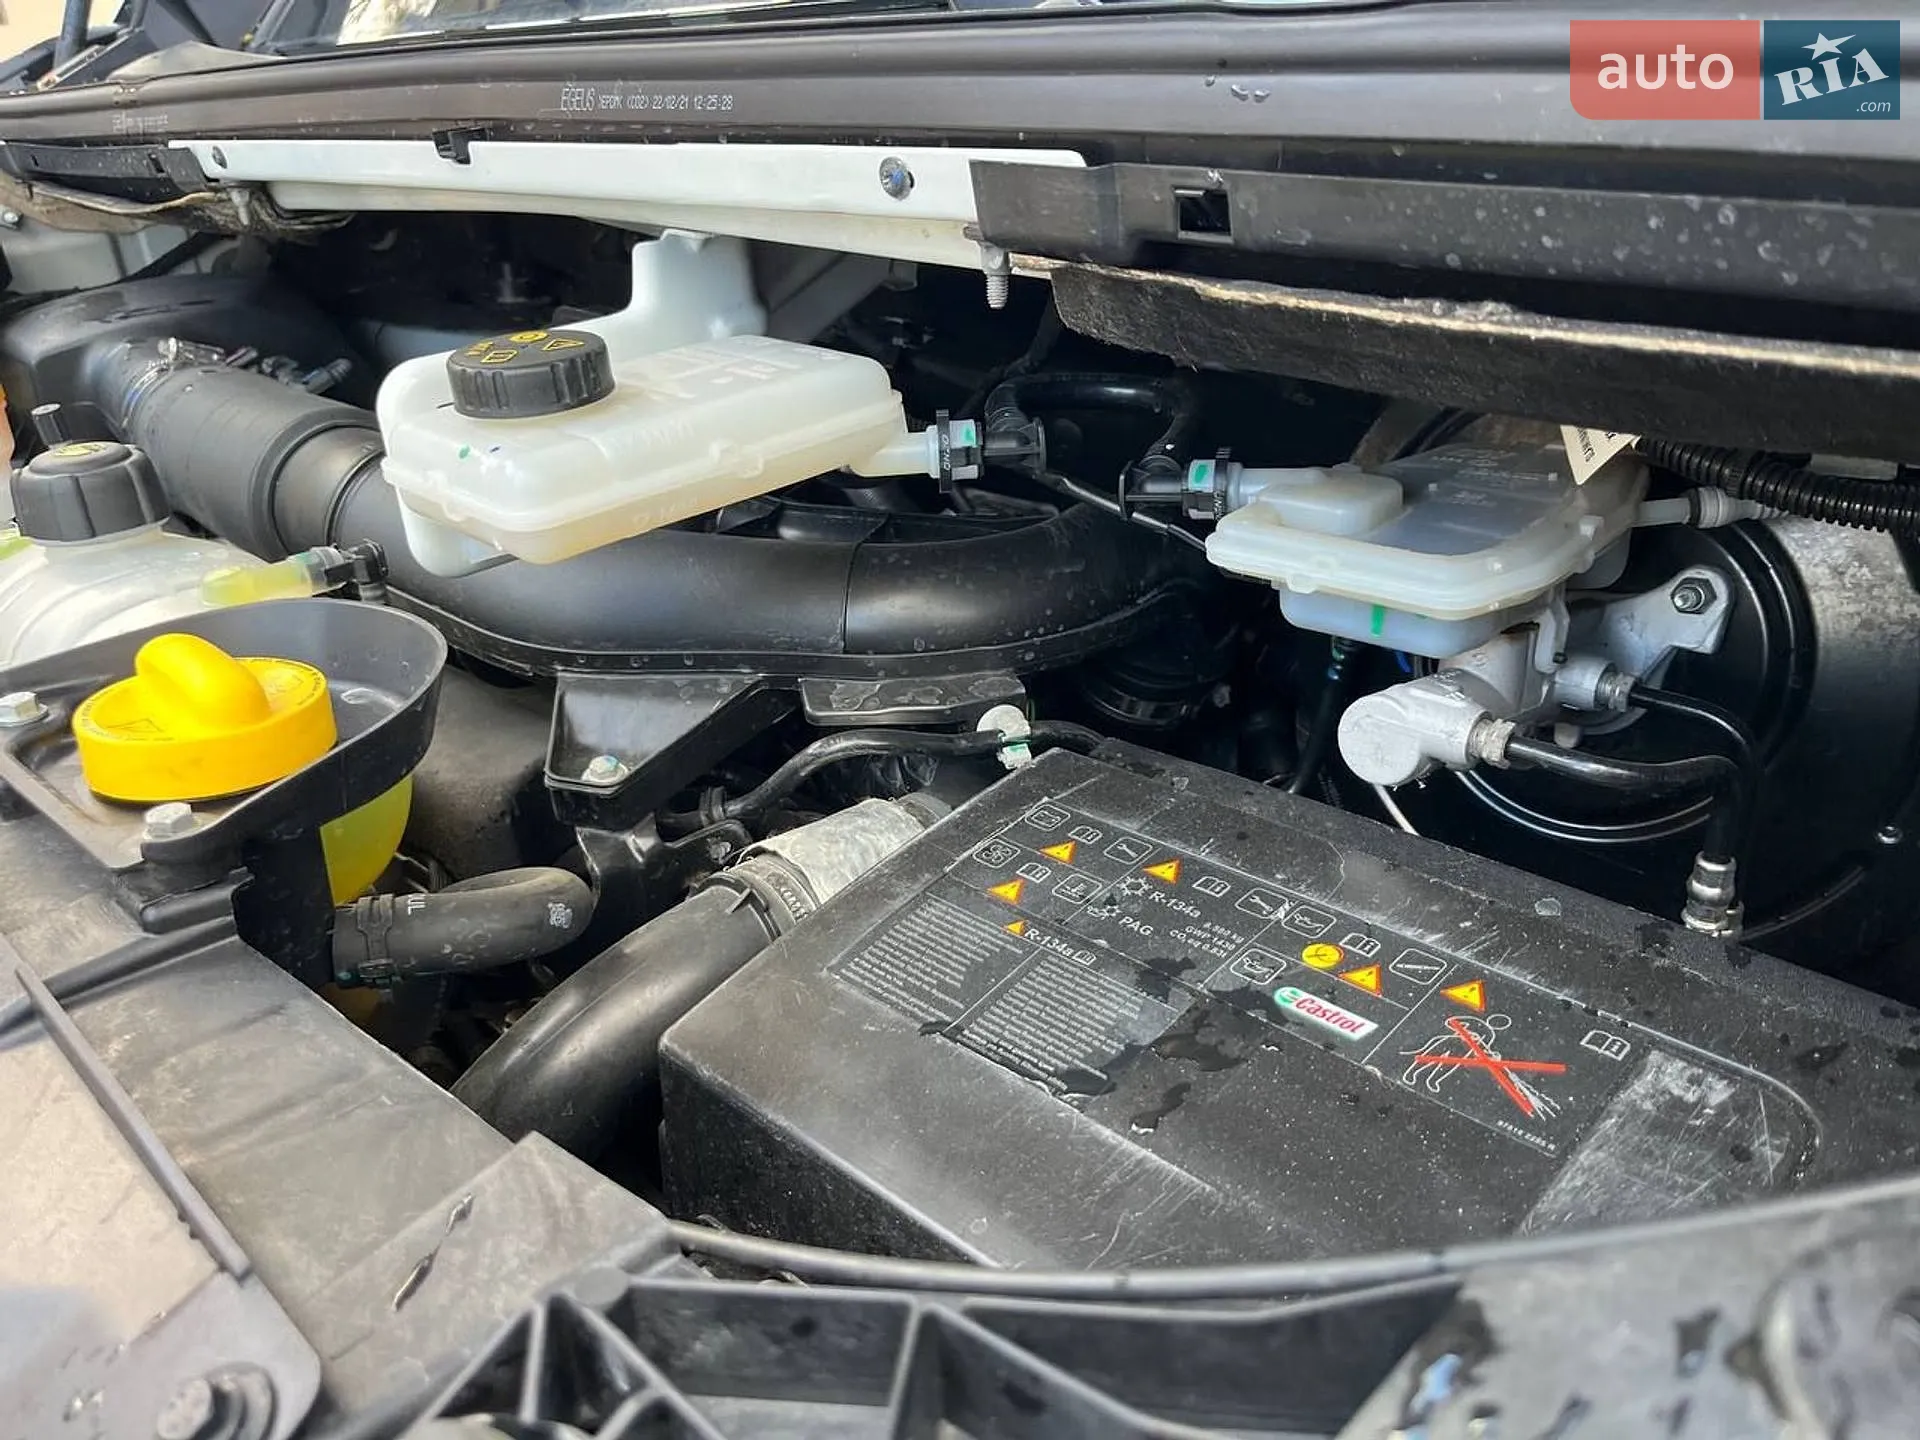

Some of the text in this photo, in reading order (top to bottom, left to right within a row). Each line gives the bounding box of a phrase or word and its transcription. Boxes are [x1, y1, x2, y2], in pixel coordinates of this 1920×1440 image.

[1149, 890, 1202, 918] R-134a
[1118, 916, 1154, 936] PAG
[1024, 928, 1074, 957] R-134a
[1295, 997, 1367, 1034] Castrol
